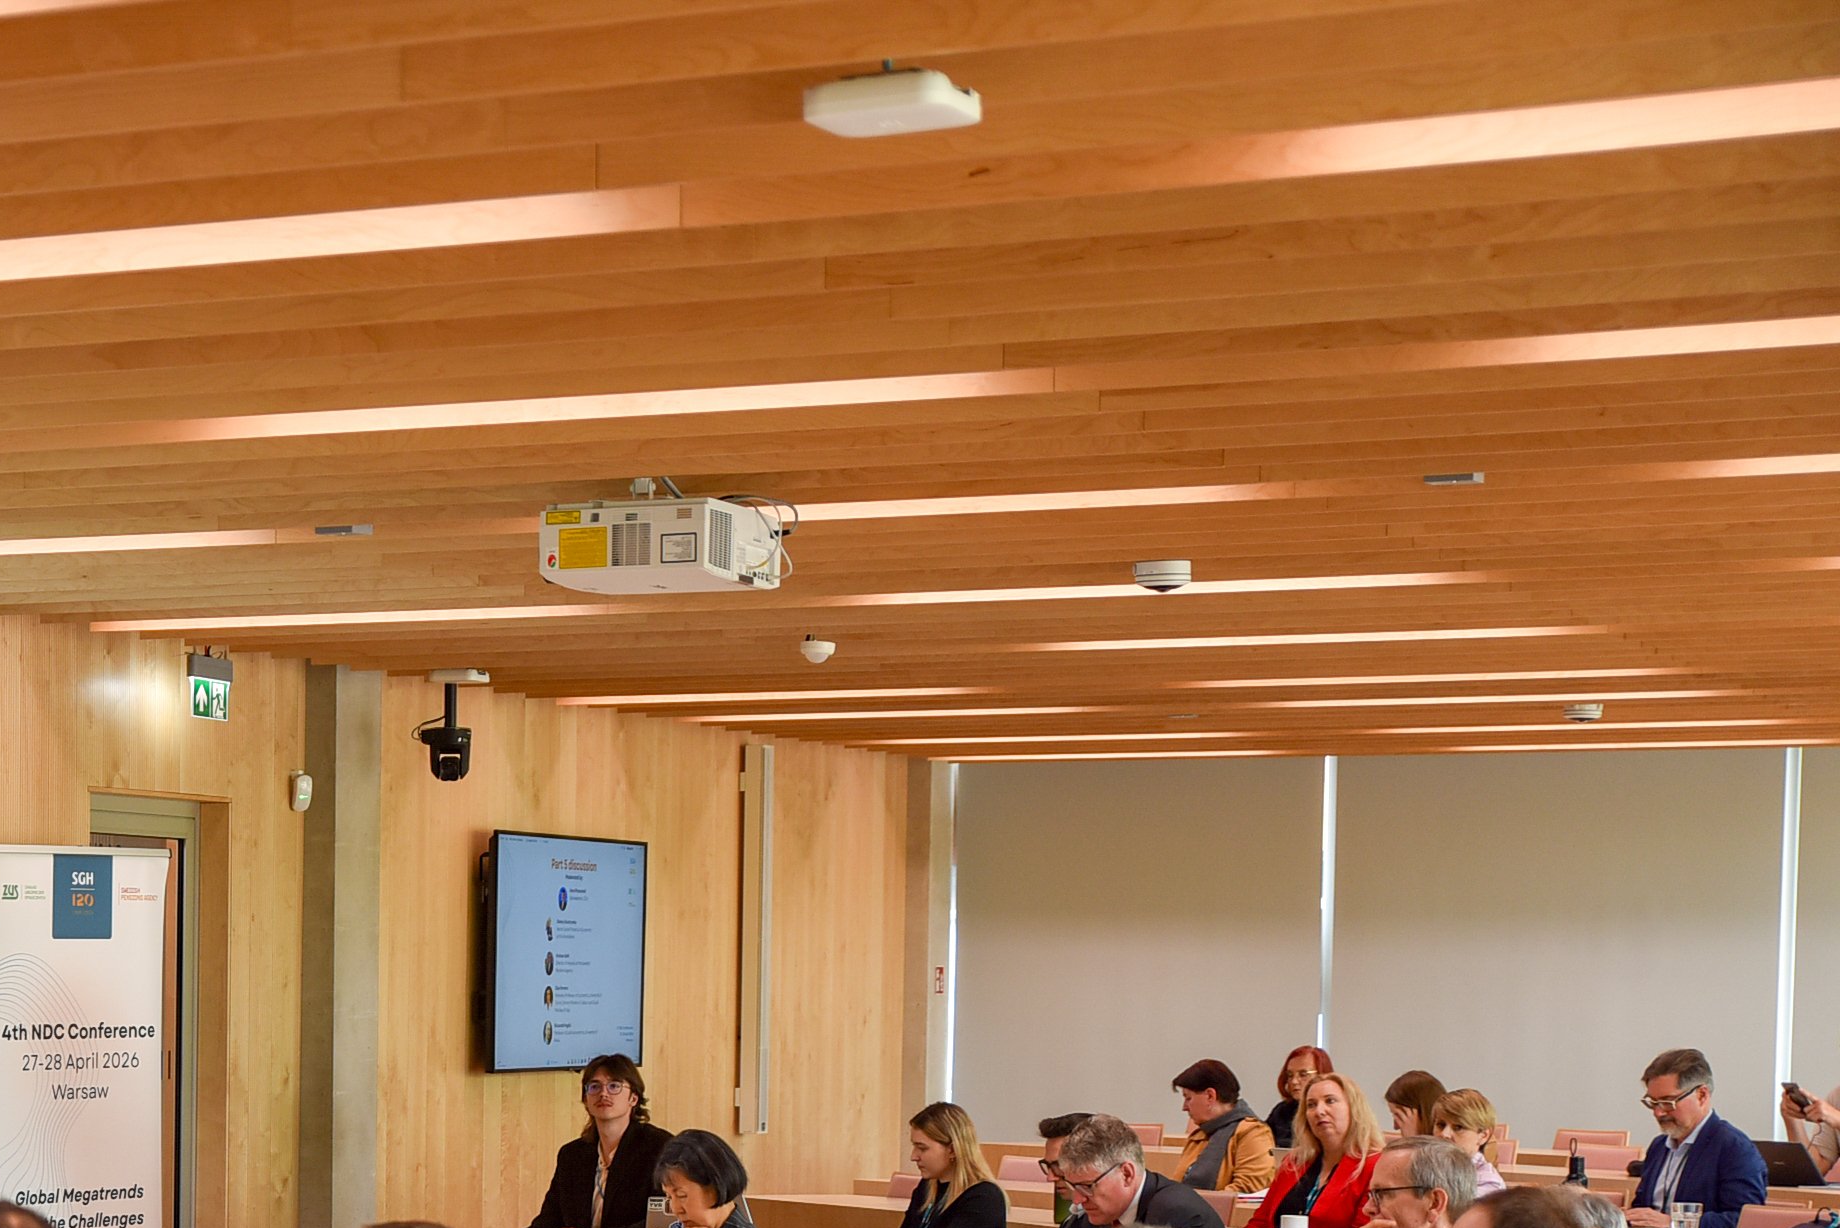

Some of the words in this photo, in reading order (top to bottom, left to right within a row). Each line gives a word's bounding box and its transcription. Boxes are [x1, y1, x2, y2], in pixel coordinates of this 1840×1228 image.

[71, 871, 94, 886] SGH
[1, 884, 19, 900] ZUS
[1, 1024, 28, 1041] 4th
[31, 1024, 65, 1040] NDC
[68, 1022, 156, 1039] Conference
[22, 1054, 62, 1071] 27-28
[65, 1052, 99, 1073] April
[103, 1052, 140, 1069] 2026
[51, 1084, 110, 1101] Warsaw
[15, 1188, 59, 1207] Global
[62, 1184, 144, 1206] Megatrends
